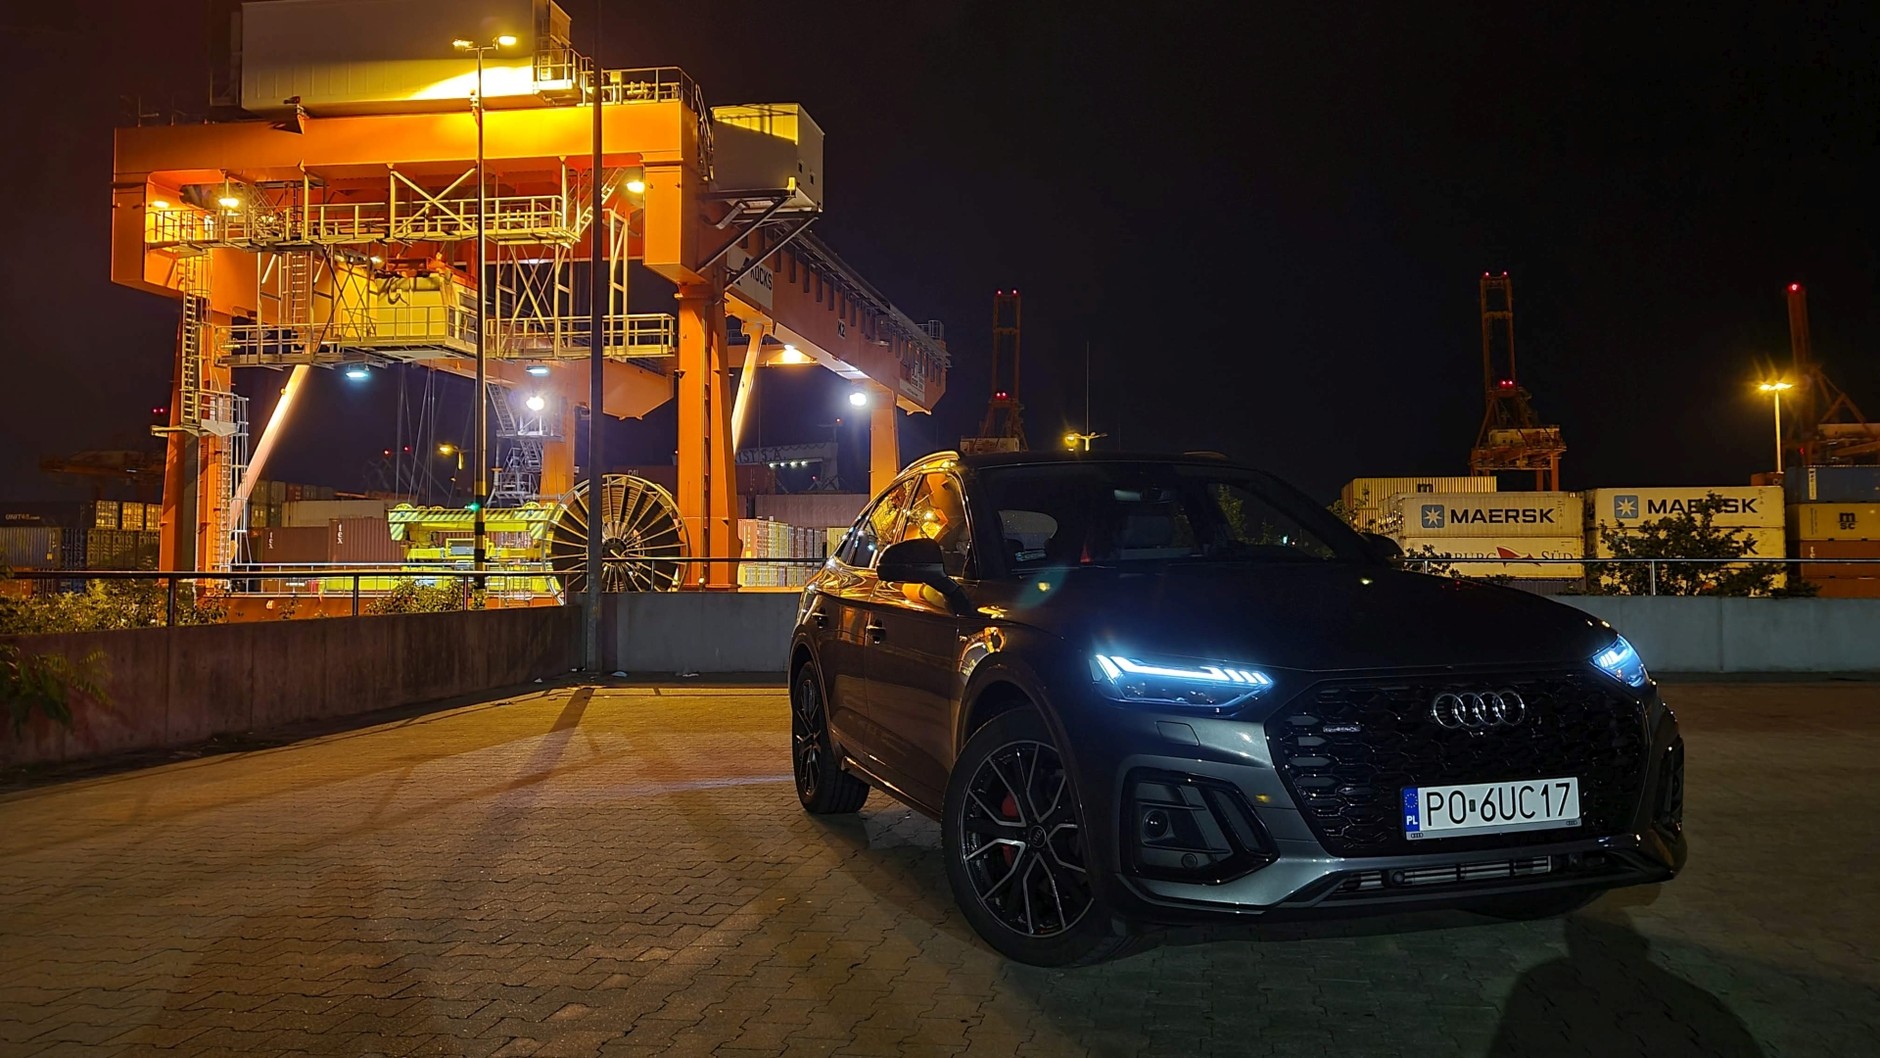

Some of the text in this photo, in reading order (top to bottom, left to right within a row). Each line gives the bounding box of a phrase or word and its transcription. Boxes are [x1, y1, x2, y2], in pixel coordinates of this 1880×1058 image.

[1450, 508, 1555, 524] MAERSK
[1480, 782, 1571, 822] 6UC17
[1406, 815, 1418, 826] PL
